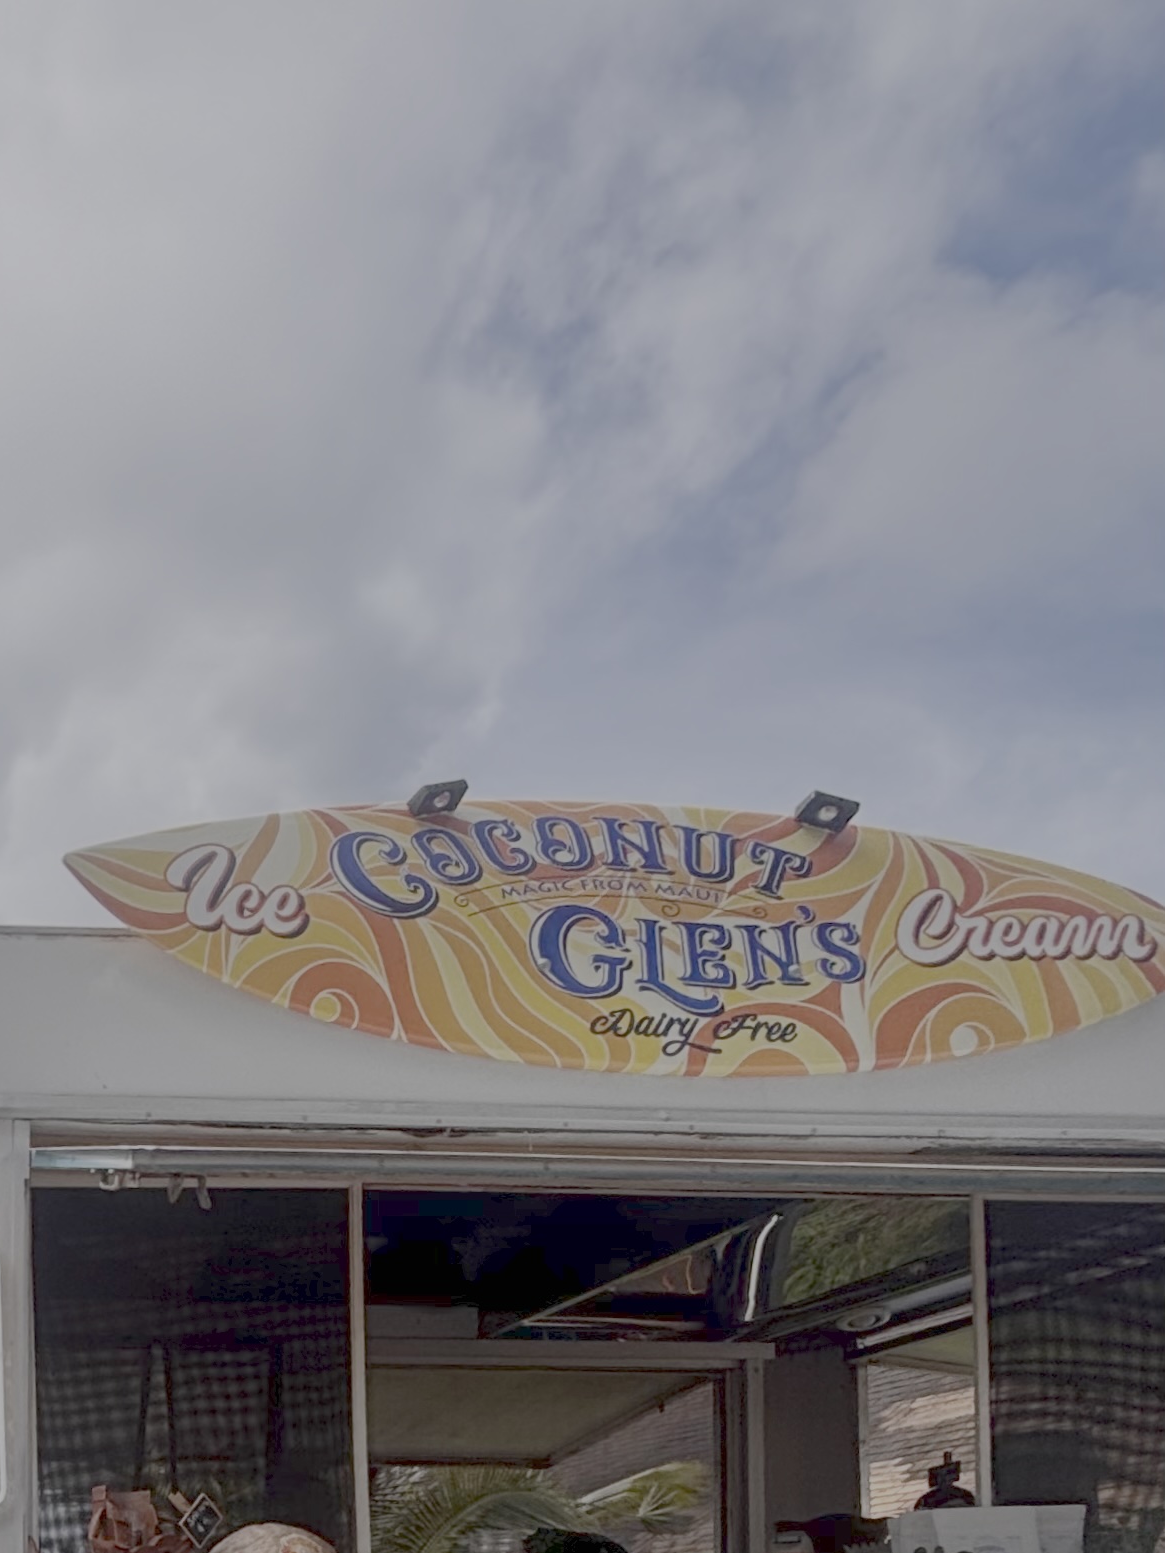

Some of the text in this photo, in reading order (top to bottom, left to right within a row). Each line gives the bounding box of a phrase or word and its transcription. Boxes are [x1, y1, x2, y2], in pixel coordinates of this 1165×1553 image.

[164, 843, 310, 938] Ice
[330, 815, 811, 919] COCONUT
[501, 878, 722, 903] MAGIC FROM MAUI
[529, 905, 866, 1017] GLEN'S
[896, 888, 1157, 967] Cream
[590, 1008, 798, 1057] Dairy Free
